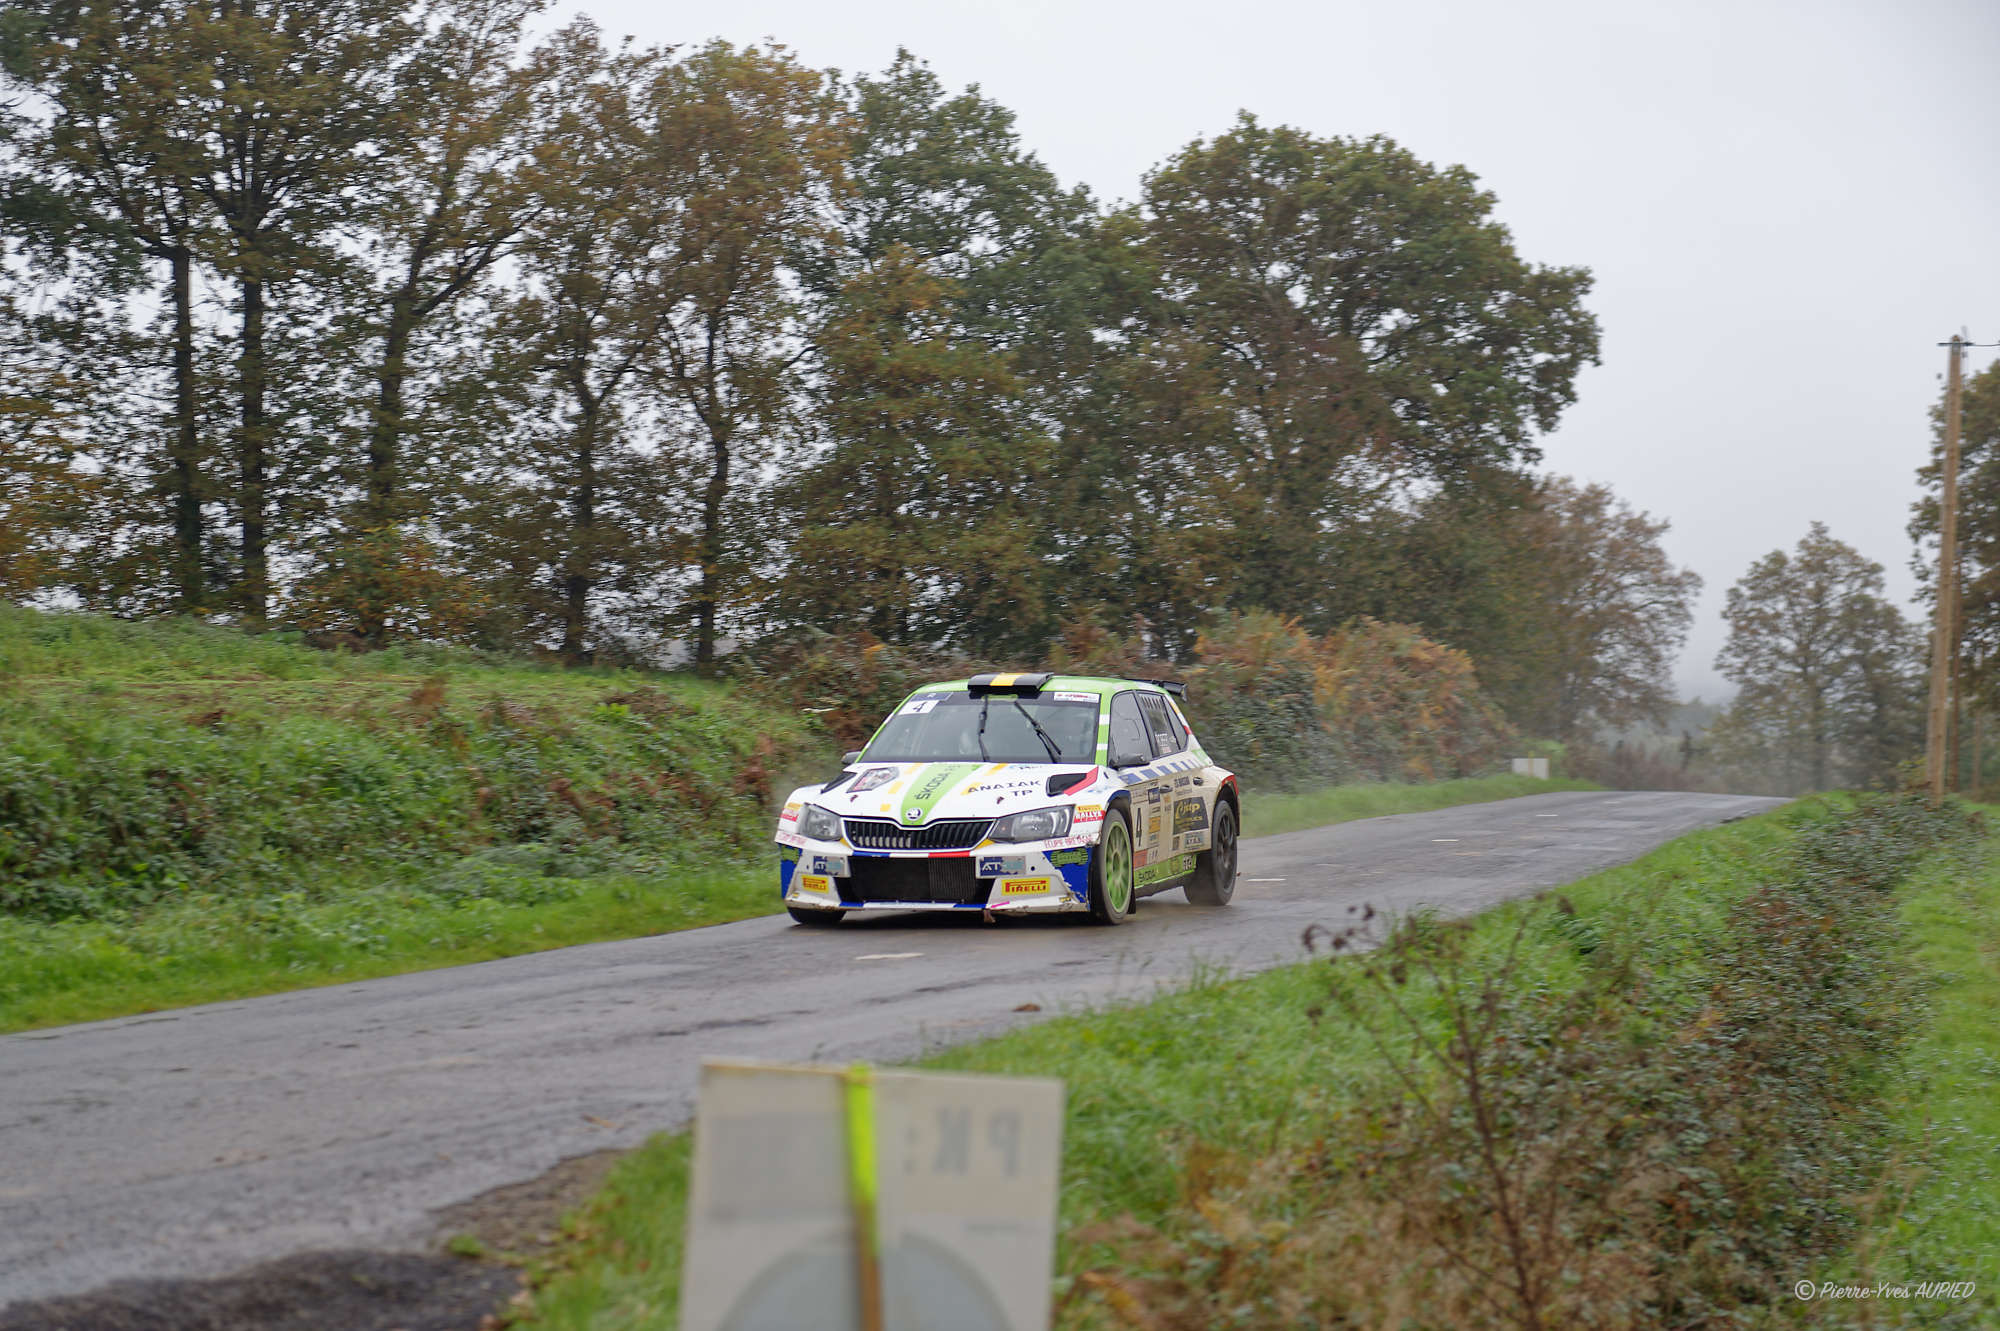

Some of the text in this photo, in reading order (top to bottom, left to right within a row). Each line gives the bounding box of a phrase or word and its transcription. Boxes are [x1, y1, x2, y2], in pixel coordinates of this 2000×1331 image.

[912, 701, 927, 713] 4
[1011, 789, 1033, 797] TP
[1135, 807, 1142, 847] 4
[1005, 880, 1047, 893] PIRELLI
